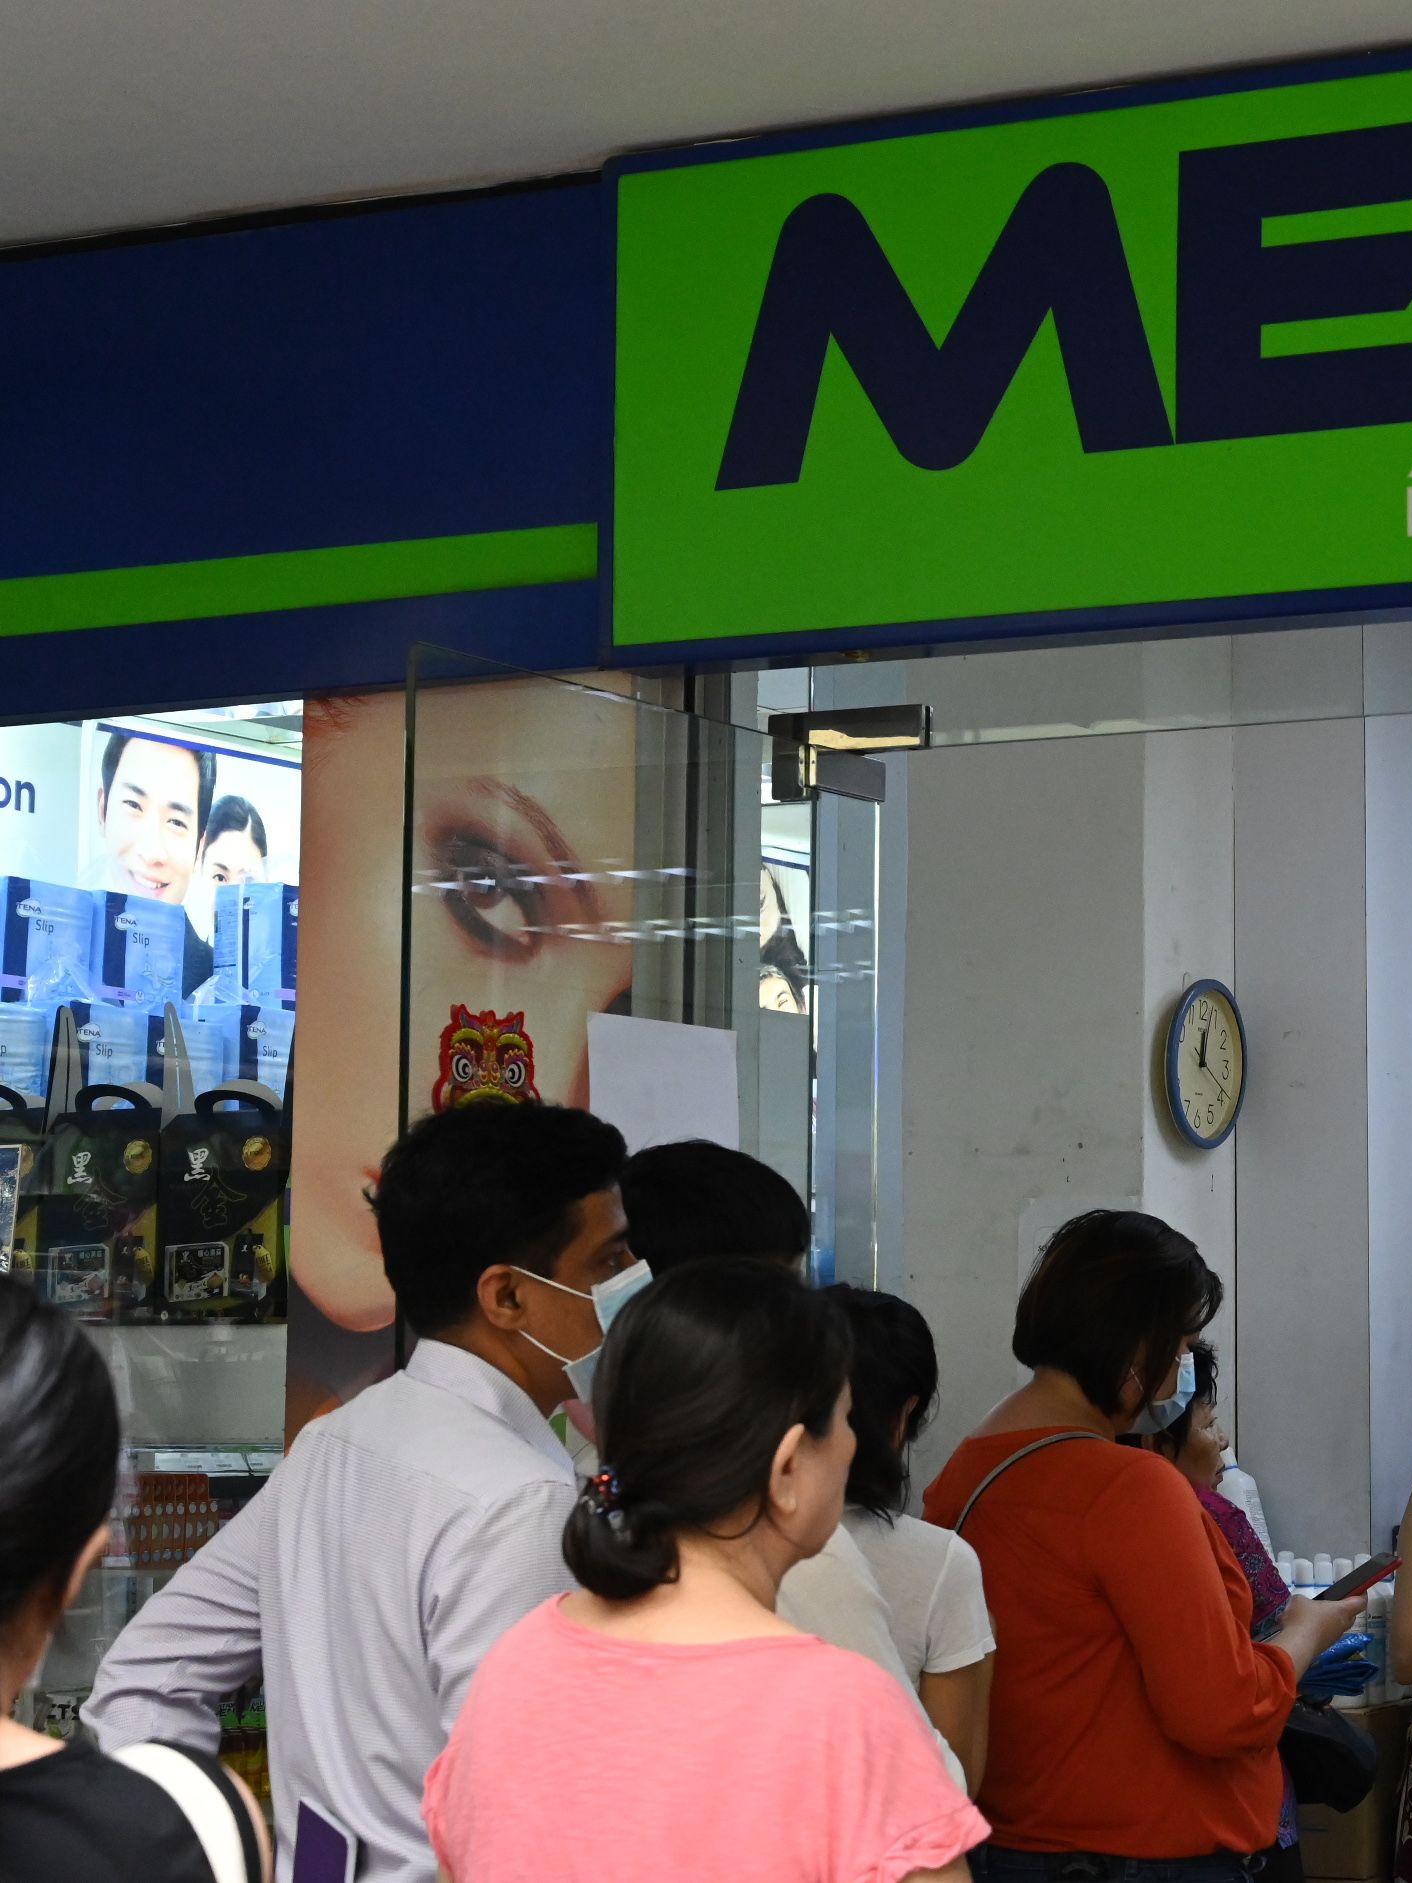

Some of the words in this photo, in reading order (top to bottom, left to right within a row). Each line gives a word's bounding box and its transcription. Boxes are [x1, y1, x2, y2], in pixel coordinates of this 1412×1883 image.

[16, 902, 42, 914] TENA
[35, 919, 54, 935] Slip
[114, 915, 137, 926] TENA
[132, 932, 150, 947] Slip
[78, 1028, 101, 1037] TENA
[247, 1026, 267, 1035] TENA
[95, 1043, 113, 1058] Slip
[263, 1045, 278, 1058] Slip
[67, 1151, 93, 1184] 黑
[183, 1148, 210, 1182] 黑
